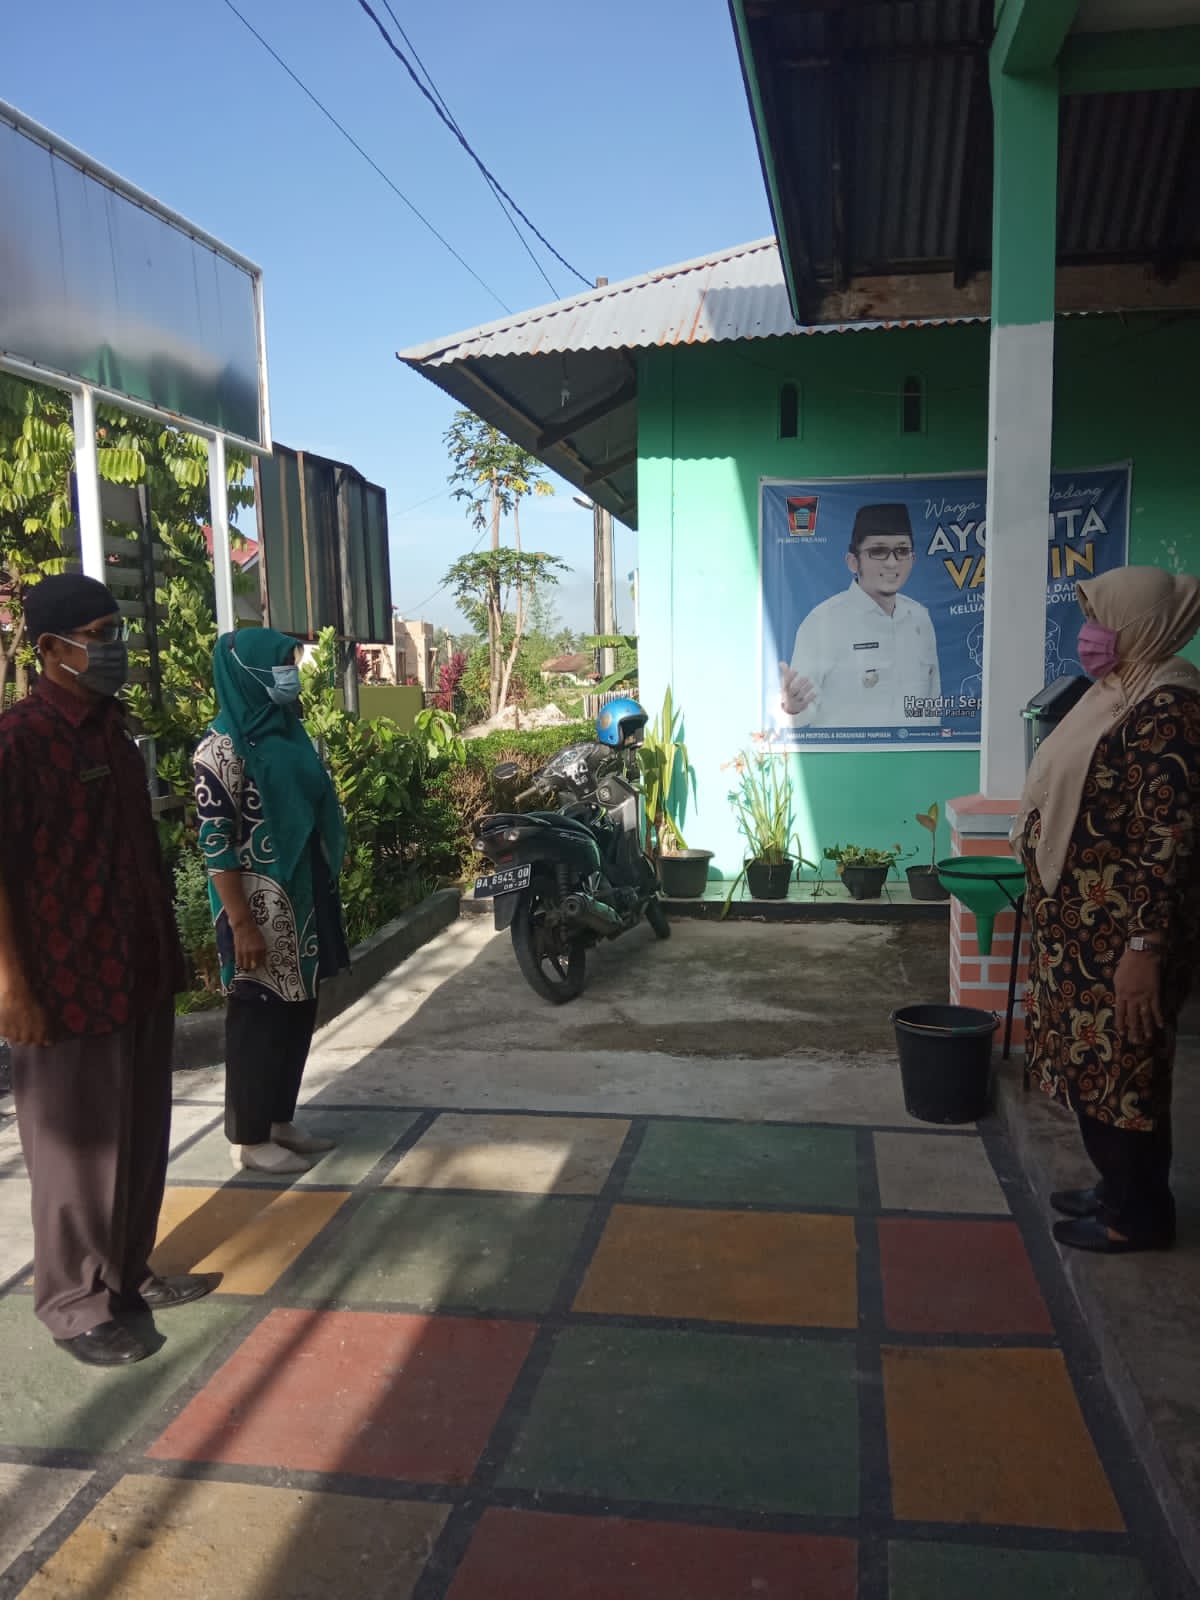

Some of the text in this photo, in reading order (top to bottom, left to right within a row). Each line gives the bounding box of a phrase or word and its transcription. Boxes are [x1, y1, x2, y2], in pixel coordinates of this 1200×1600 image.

[925, 497, 980, 522] Warga
[904, 695, 954, 709] Hendri
[476, 878, 488, 889] BA
